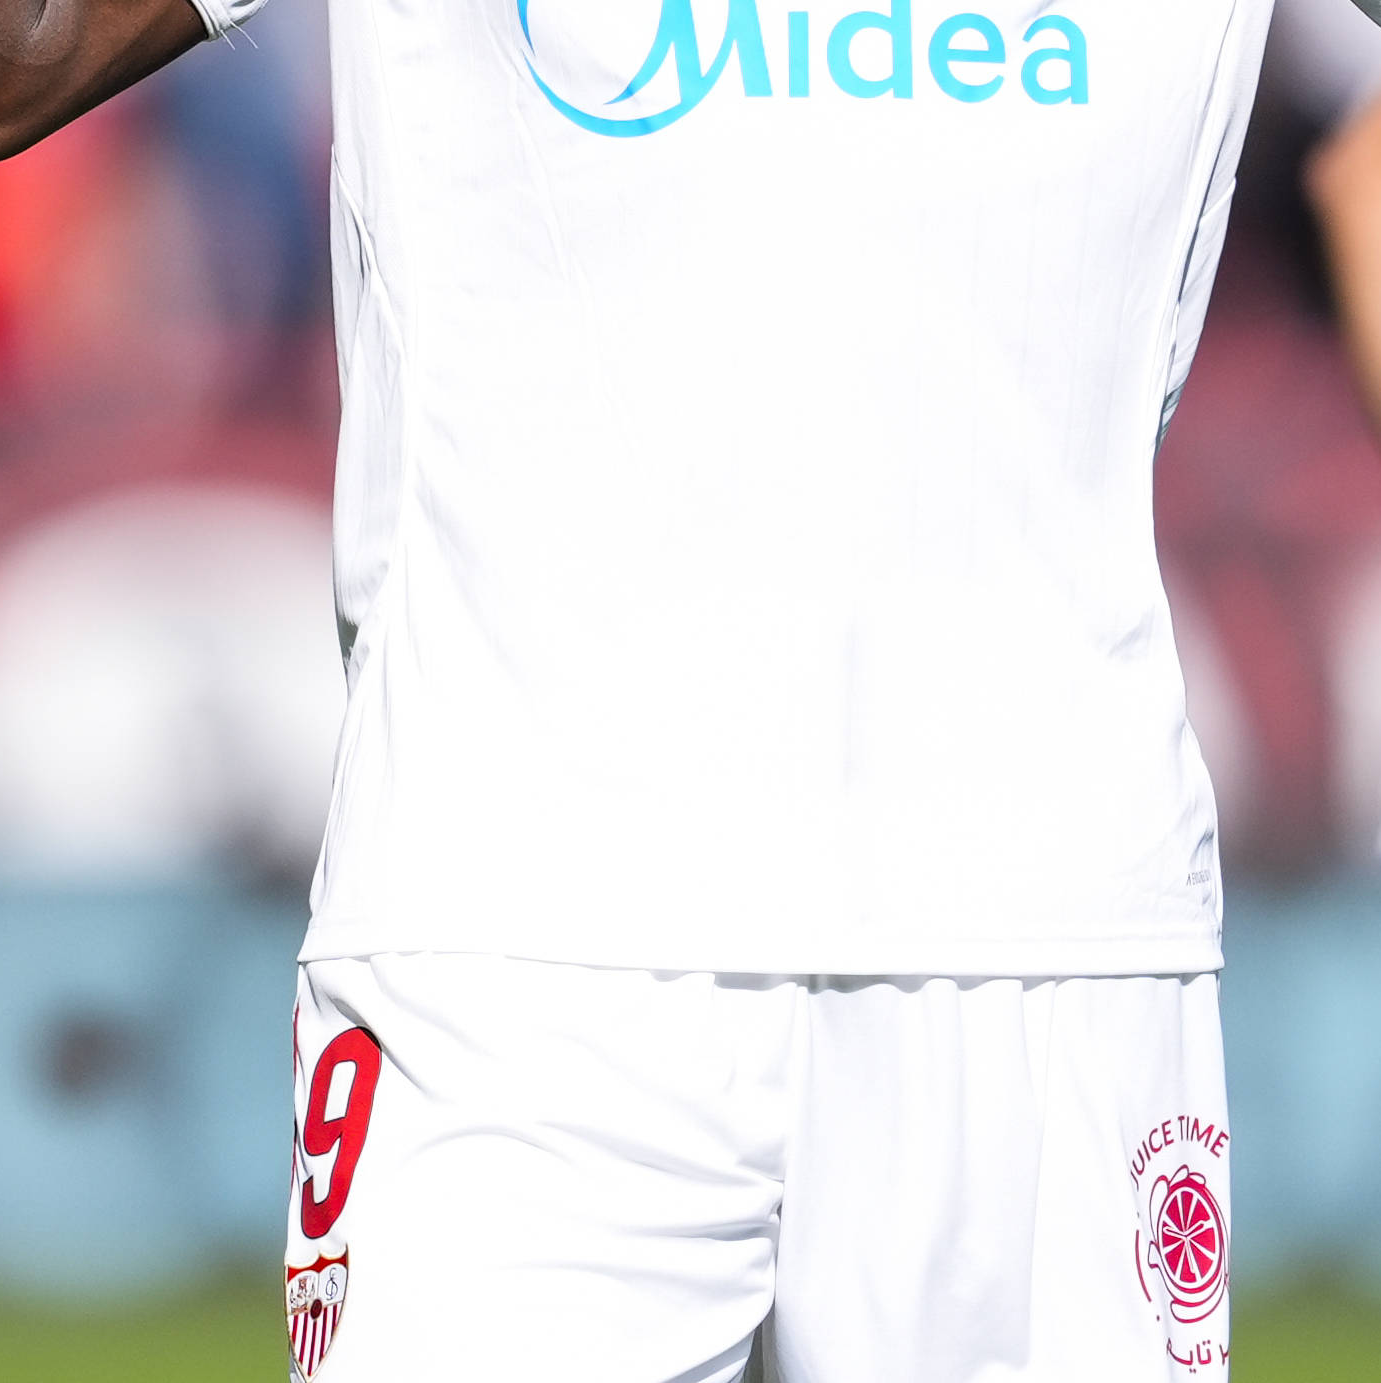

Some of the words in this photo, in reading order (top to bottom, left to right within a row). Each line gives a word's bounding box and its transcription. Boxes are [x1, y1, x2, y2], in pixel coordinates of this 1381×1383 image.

[301, 1026, 382, 1239] 9
[1130, 1120, 1175, 1192] JUICE
[1178, 1115, 1229, 1158] TIME
